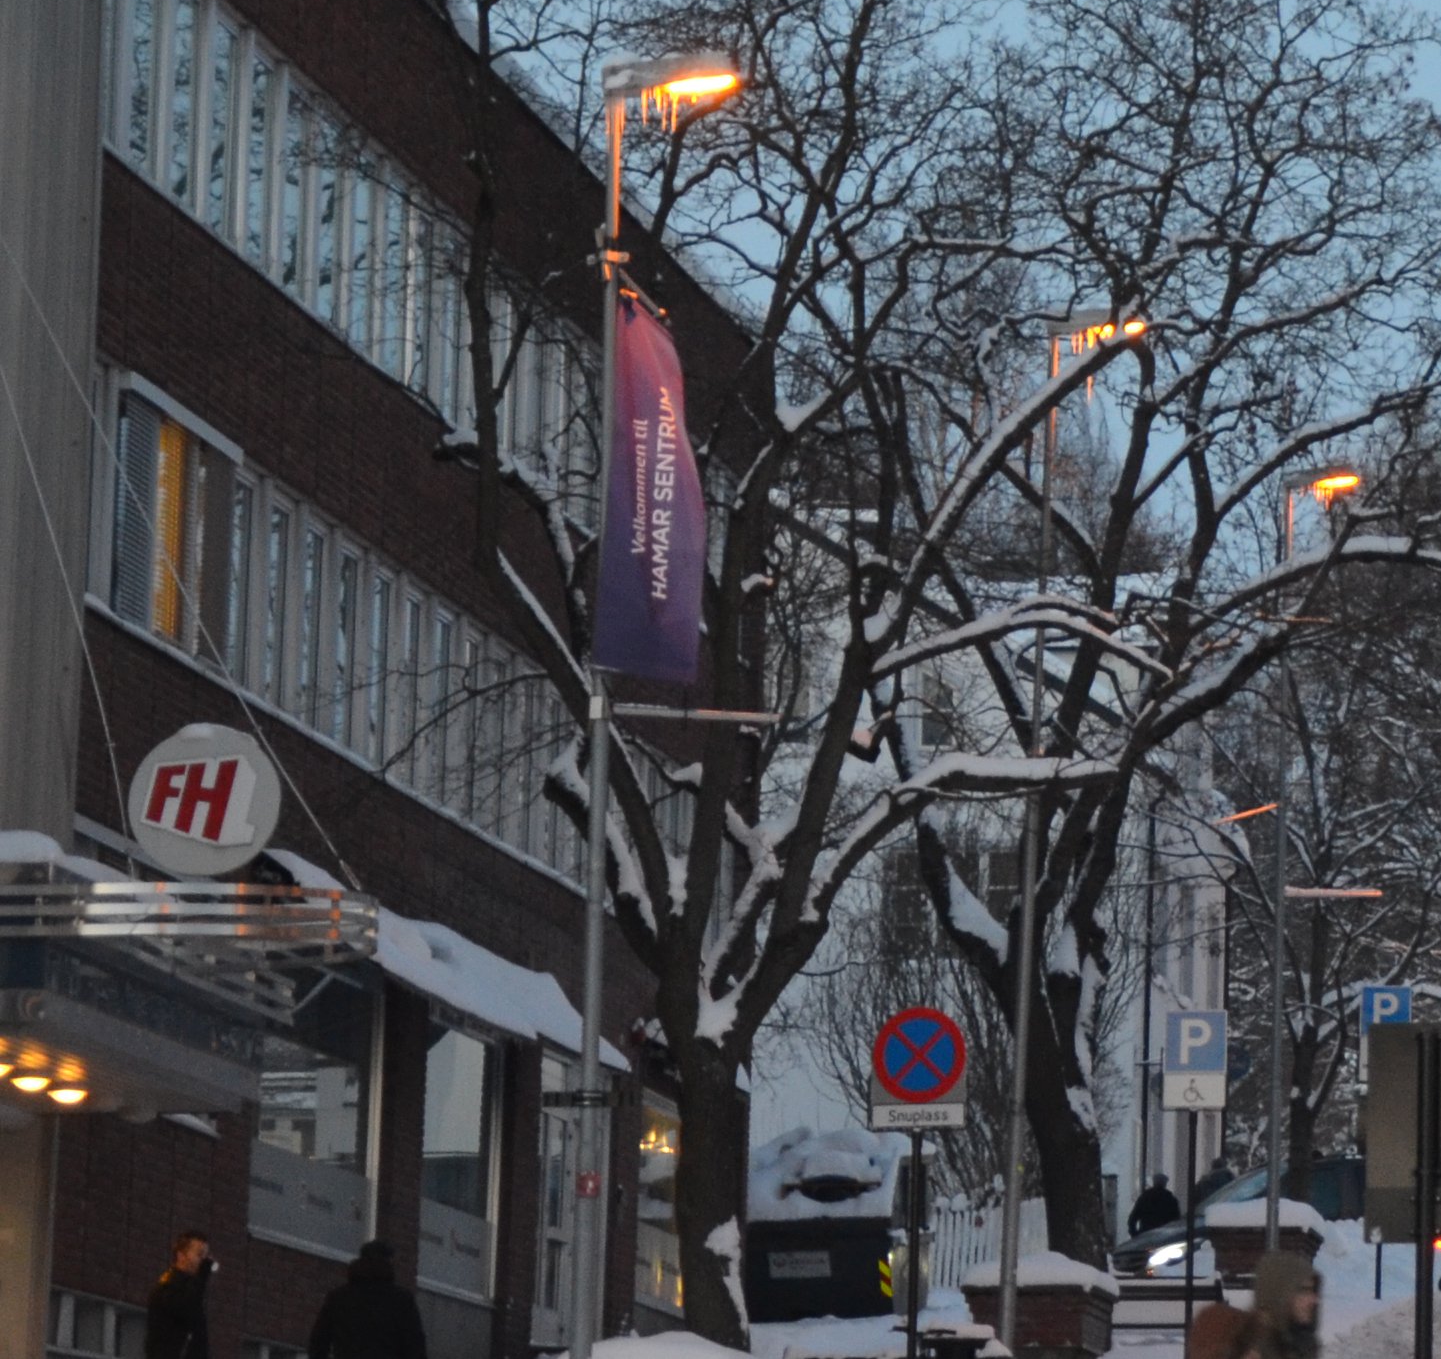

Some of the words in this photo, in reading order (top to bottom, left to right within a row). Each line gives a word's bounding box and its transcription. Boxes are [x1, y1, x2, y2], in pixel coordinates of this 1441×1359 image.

[633, 419, 648, 438] til
[653, 386, 676, 502] SENTRUM
[631, 444, 646, 553] Velkommen
[651, 508, 672, 600] HAMAR
[1179, 1018, 1212, 1065] P
[888, 1109, 948, 1124] Snuplass
